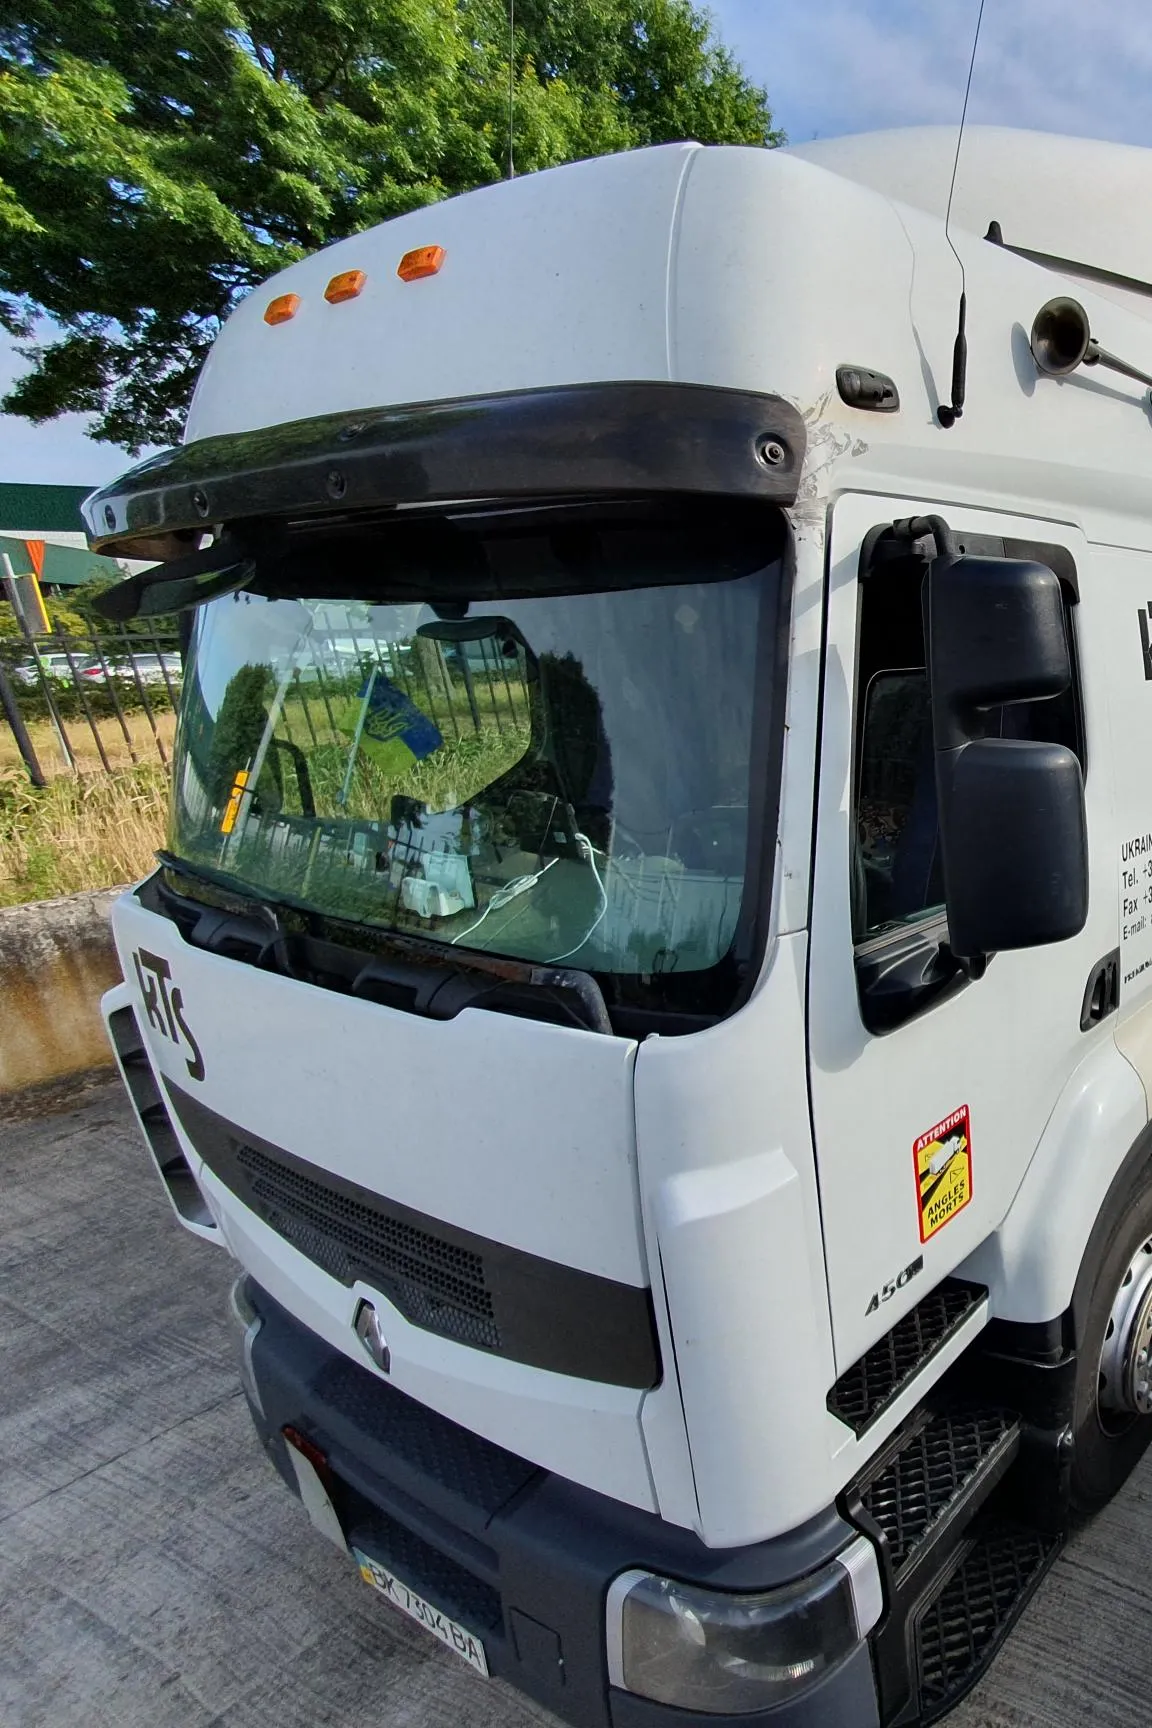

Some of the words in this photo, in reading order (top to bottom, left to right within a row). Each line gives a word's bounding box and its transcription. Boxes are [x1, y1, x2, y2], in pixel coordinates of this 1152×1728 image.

[1122, 867, 1139, 889] Tel.
[1123, 898, 1138, 918] Fax
[1123, 915, 1147, 941] E-mail:
[917, 1106, 967, 1151] ATTENTION
[927, 1179, 965, 1219] ANGLES
[929, 1191, 964, 1228] MORTS
[448, 1622, 483, 1669] BA
